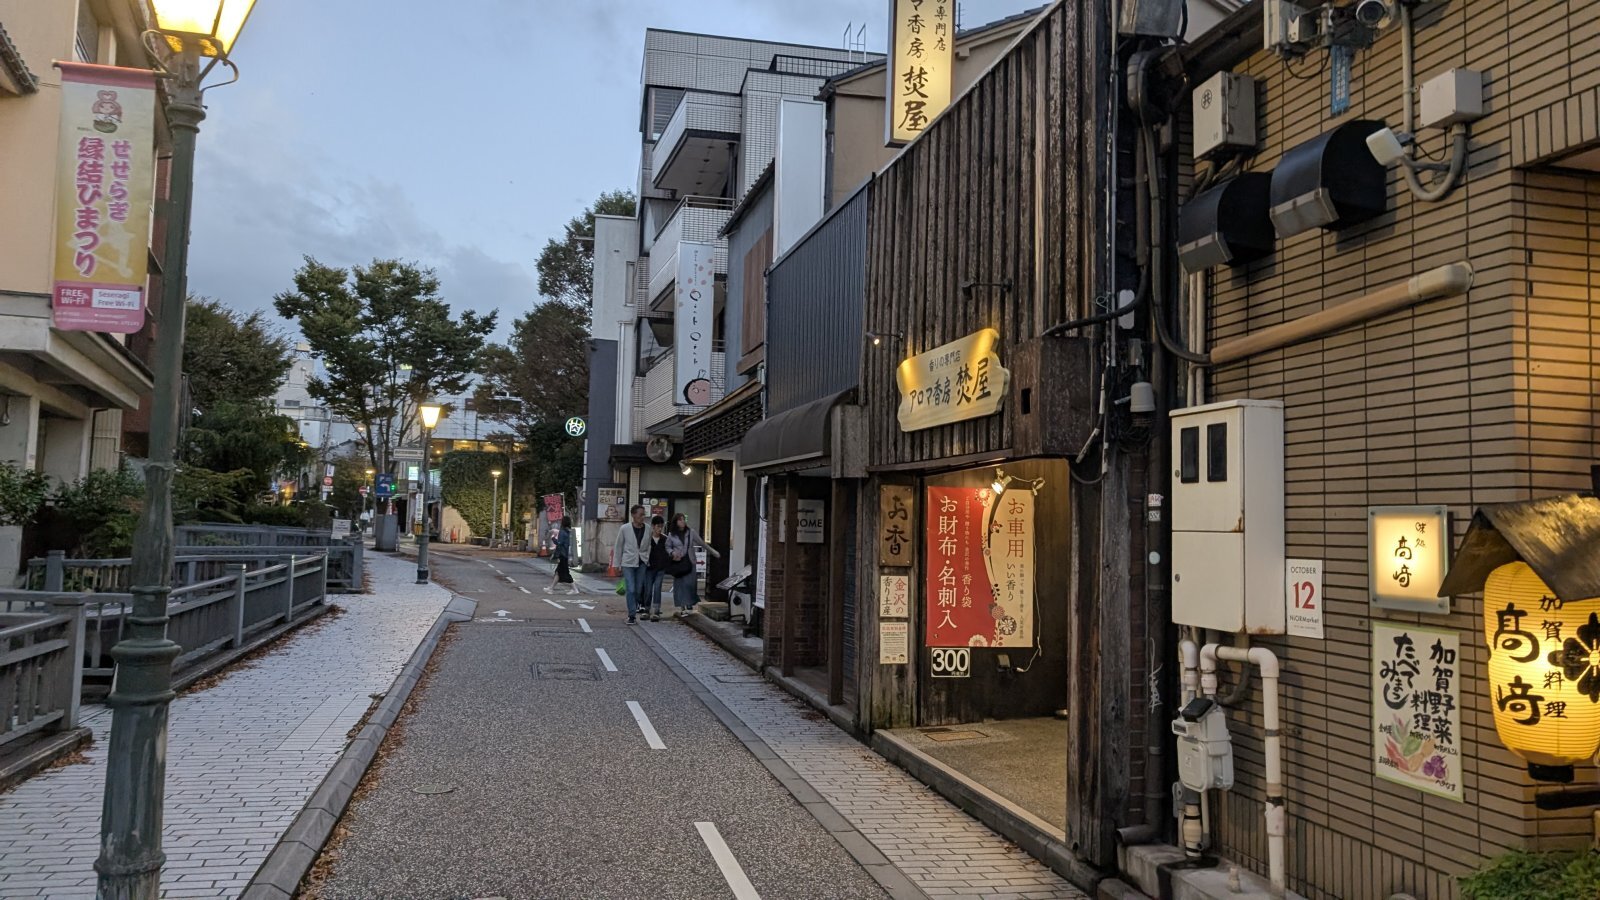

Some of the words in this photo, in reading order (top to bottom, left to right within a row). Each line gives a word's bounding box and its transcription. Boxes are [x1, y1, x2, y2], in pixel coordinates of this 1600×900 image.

[933, 0, 948, 52] 専門店
[108, 140, 131, 222] せせらぎ
[74, 136, 104, 277] 縁結びまつり
[61, 288, 83, 297] FREE
[929, 350, 961, 372] 香りの専門店
[885, 495, 910, 555] お香
[1007, 497, 1025, 558] お車用
[1006, 563, 1016, 602] いい香り
[1290, 566, 1316, 574] OCTOBER
[881, 576, 893, 616] 香り土産
[894, 577, 907, 614] 金沢の
[961, 573, 972, 608] 香り袋
[1293, 581, 1315, 609] 12
[932, 649, 969, 671] 300
